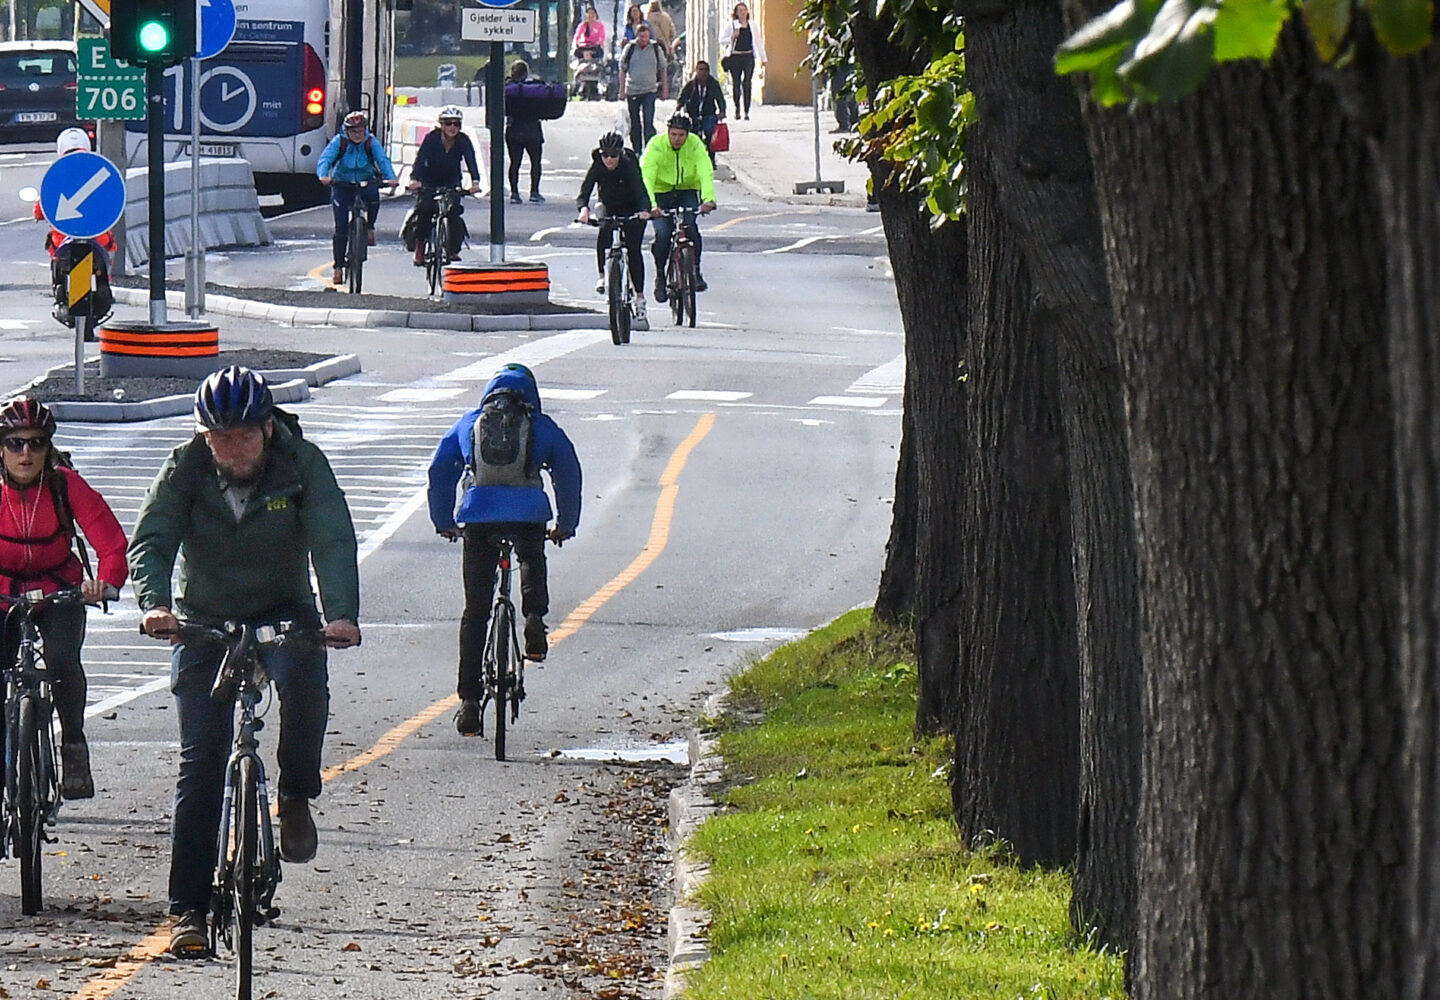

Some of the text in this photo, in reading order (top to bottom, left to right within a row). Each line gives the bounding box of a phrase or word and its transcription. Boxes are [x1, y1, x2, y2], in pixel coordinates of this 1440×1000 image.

[470, 13, 527, 24] Gjelder ikke
[251, 22, 293, 30] sentrum
[483, 26, 514, 36] sykkel
[92, 46, 106, 69] E
[85, 87, 137, 111] 706
[262, 101, 281, 109] min
